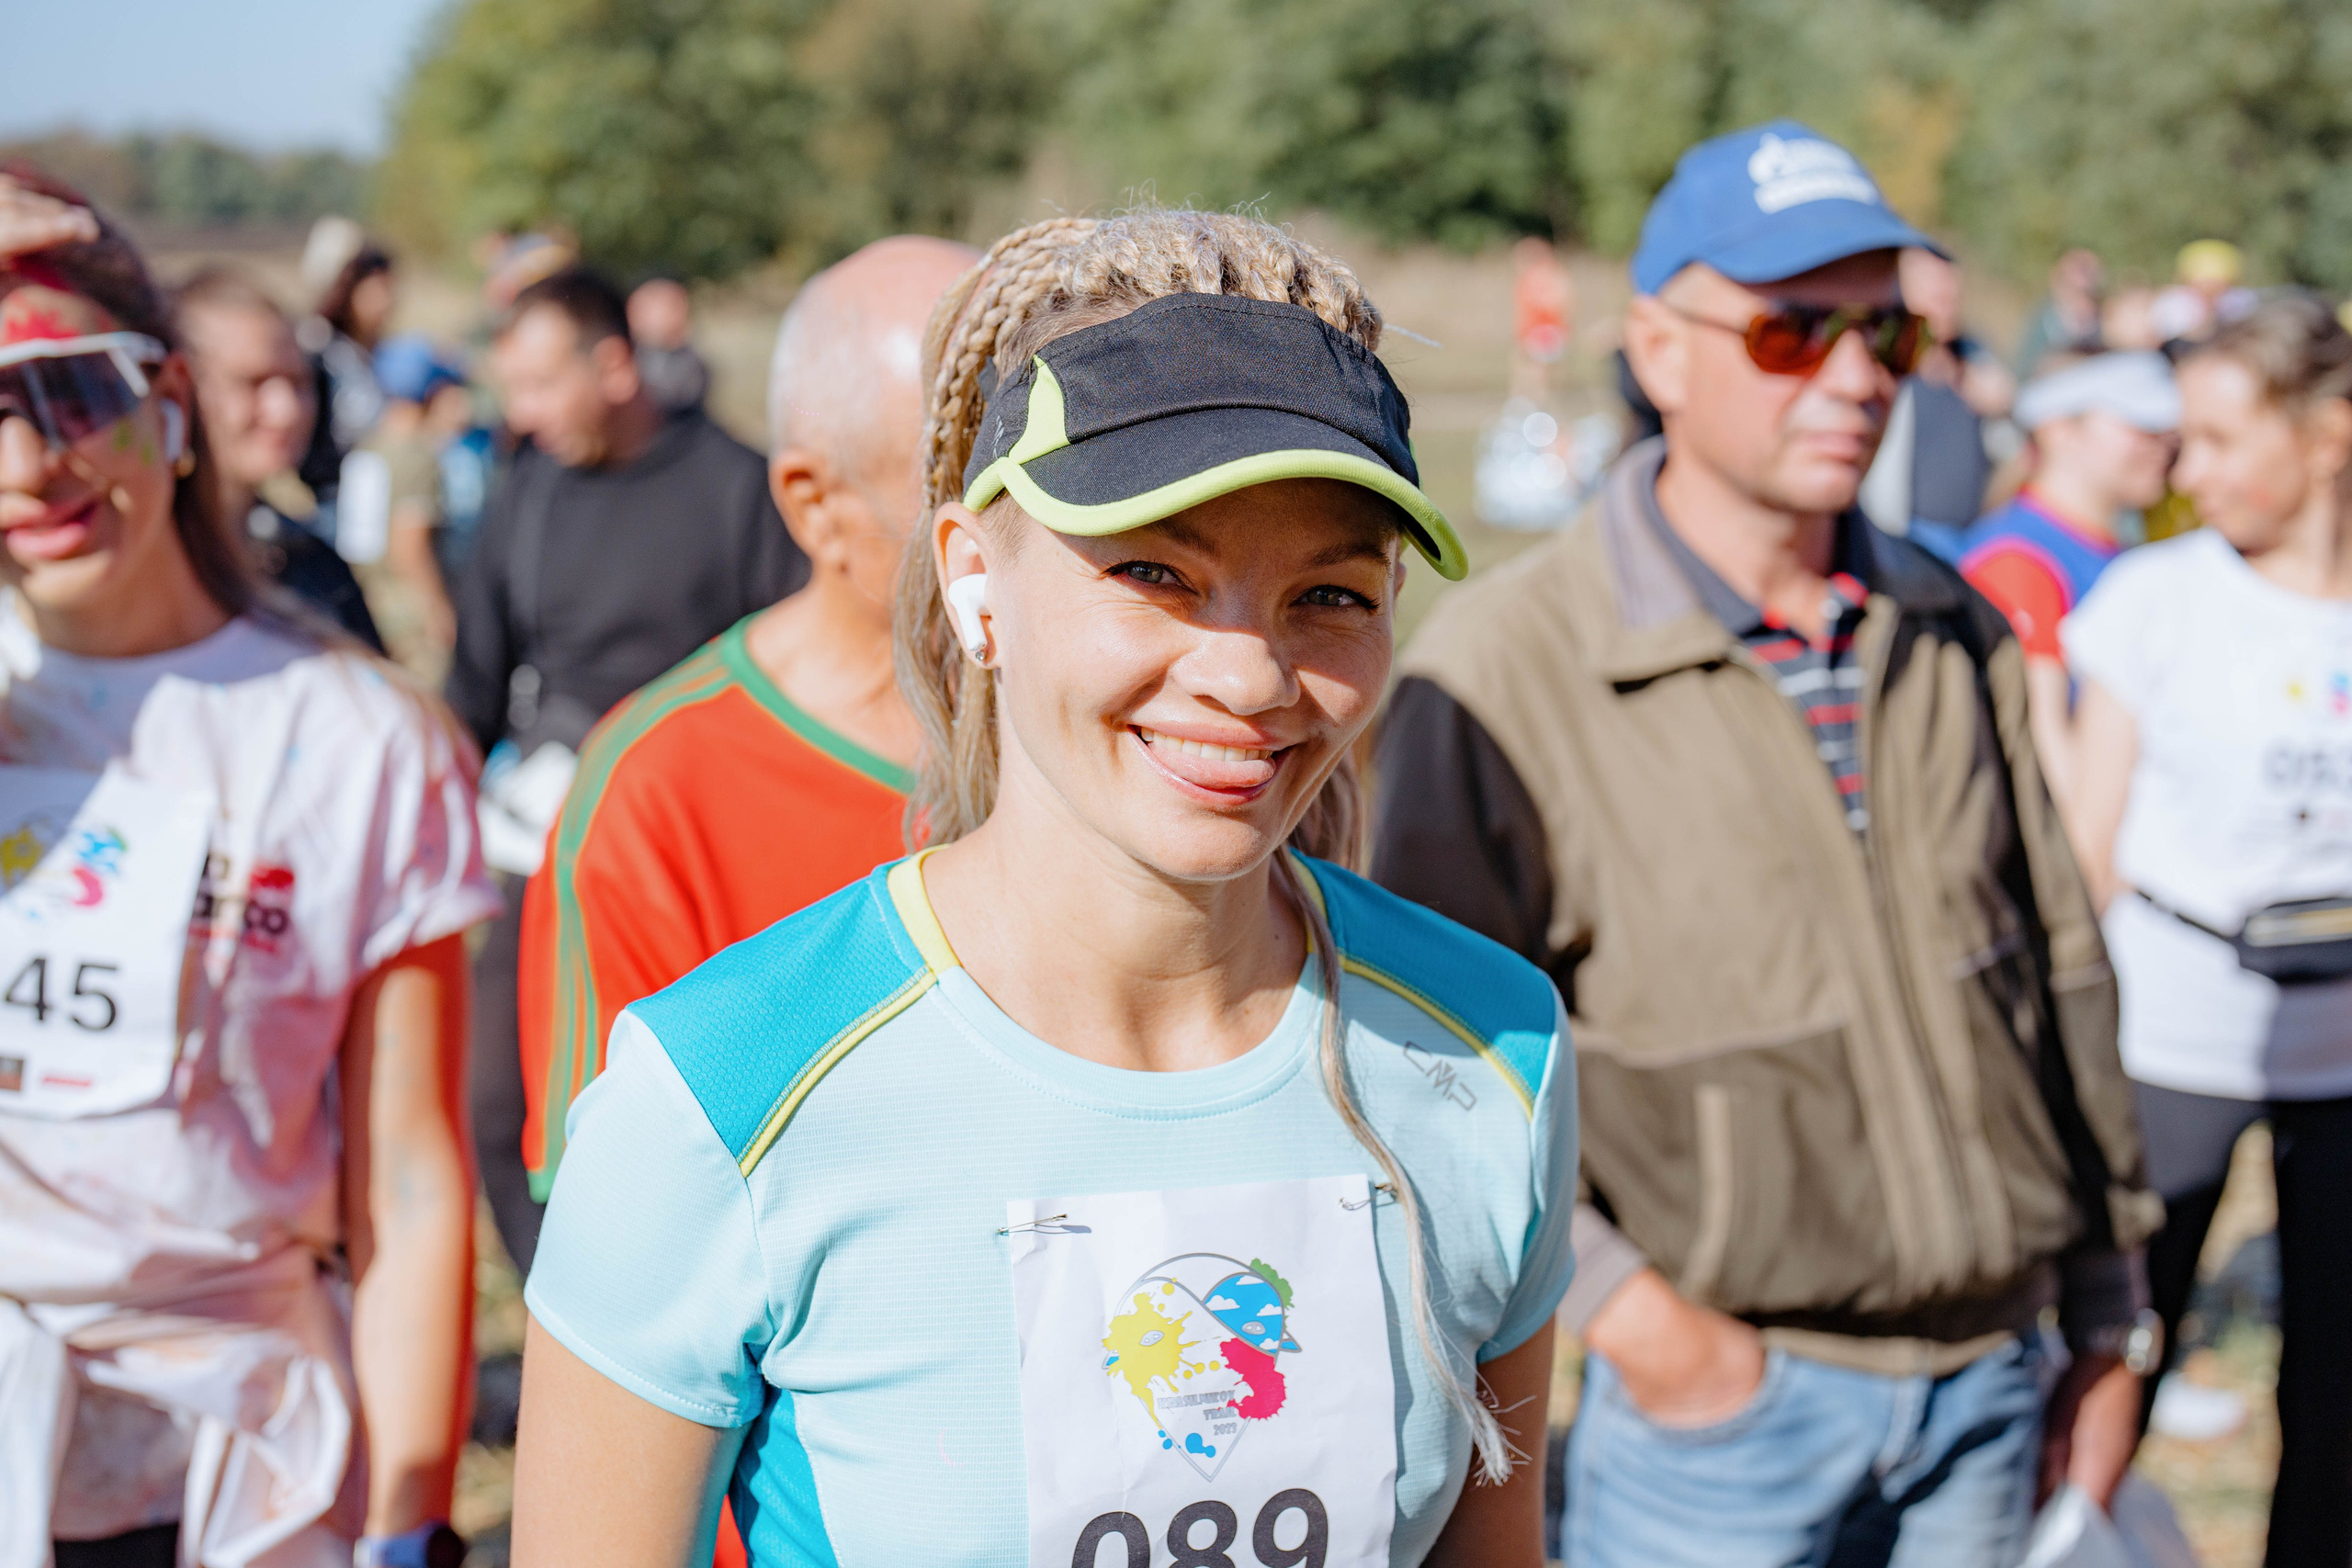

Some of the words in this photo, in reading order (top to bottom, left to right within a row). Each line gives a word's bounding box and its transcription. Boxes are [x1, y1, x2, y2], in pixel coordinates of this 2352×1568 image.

[5, 955, 119, 1031] 45
[1402, 1040, 1477, 1111] CMP
[1203, 1406, 1237, 1420] TRAIL
[1071, 1487, 1329, 1568] 089
